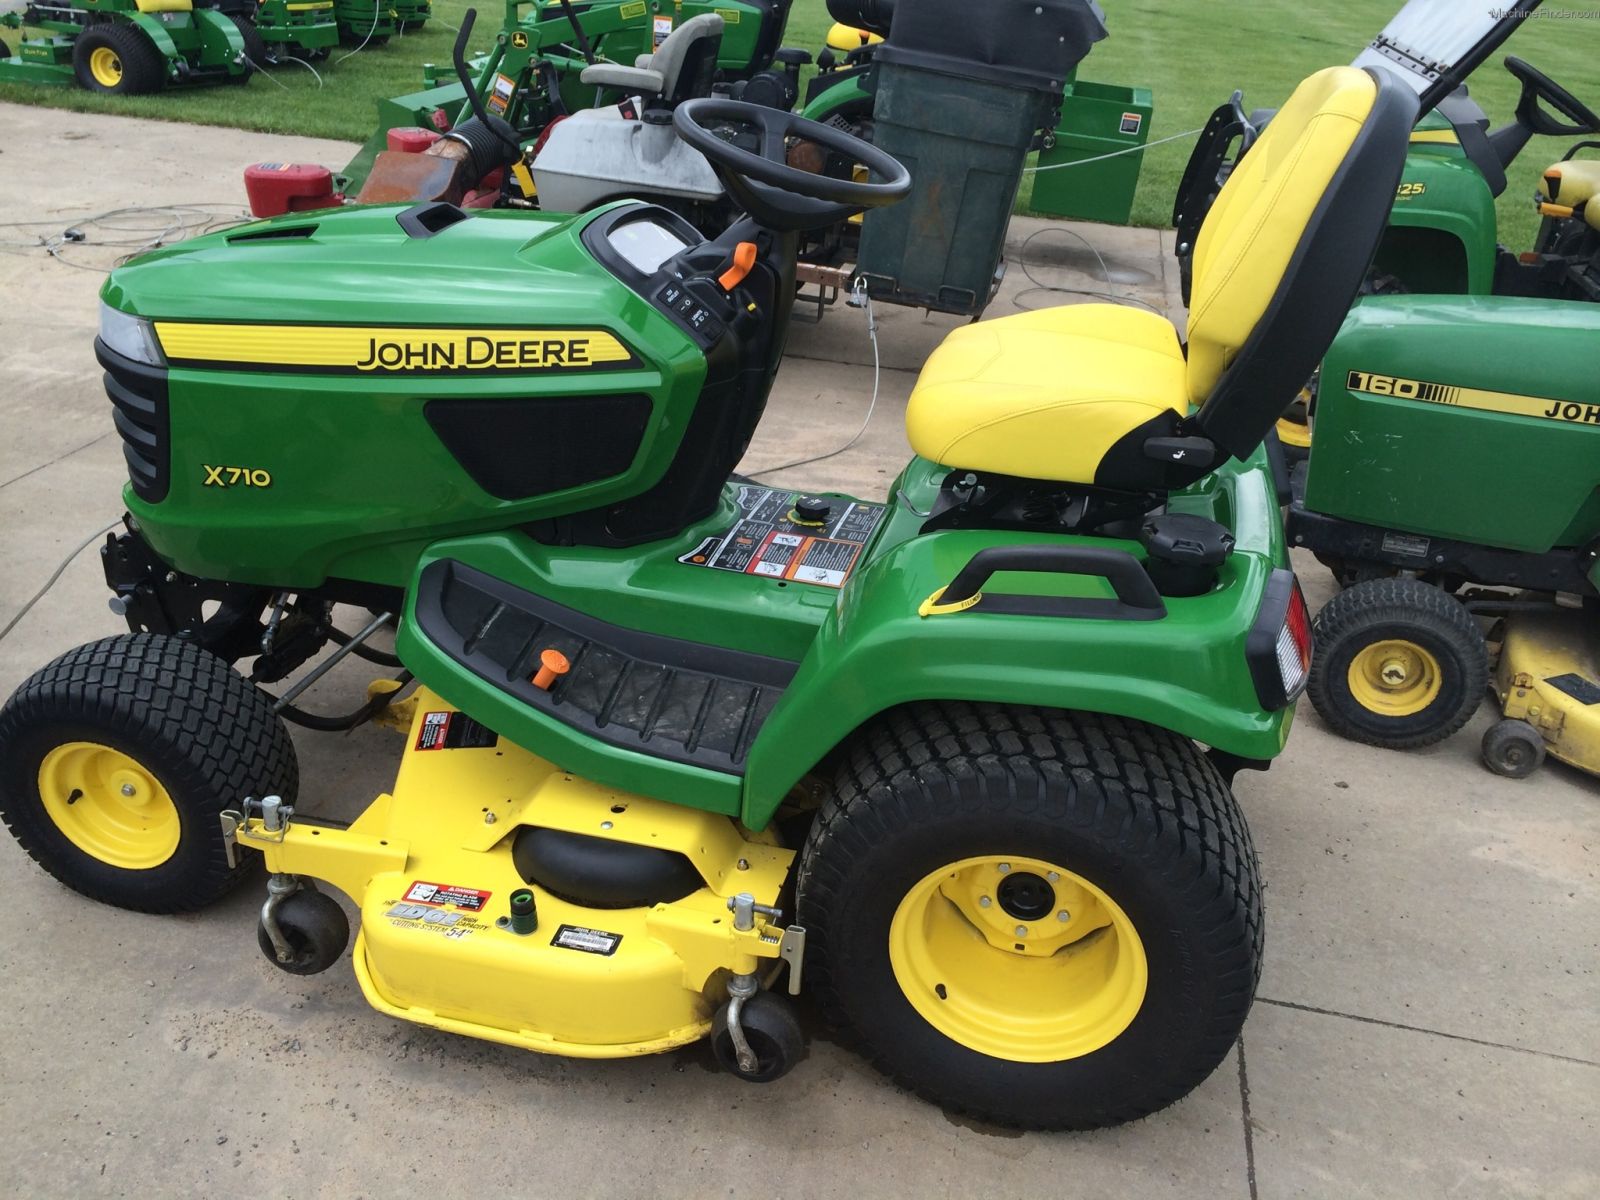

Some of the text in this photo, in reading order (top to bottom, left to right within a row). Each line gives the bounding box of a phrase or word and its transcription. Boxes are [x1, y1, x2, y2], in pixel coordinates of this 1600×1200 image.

[357, 336, 590, 368] JOHN DEERE
[1358, 373, 1420, 399] 160
[202, 464, 272, 487] X710
[454, 887, 480, 895] DANGER
[456, 920, 489, 931] CAPACITY
